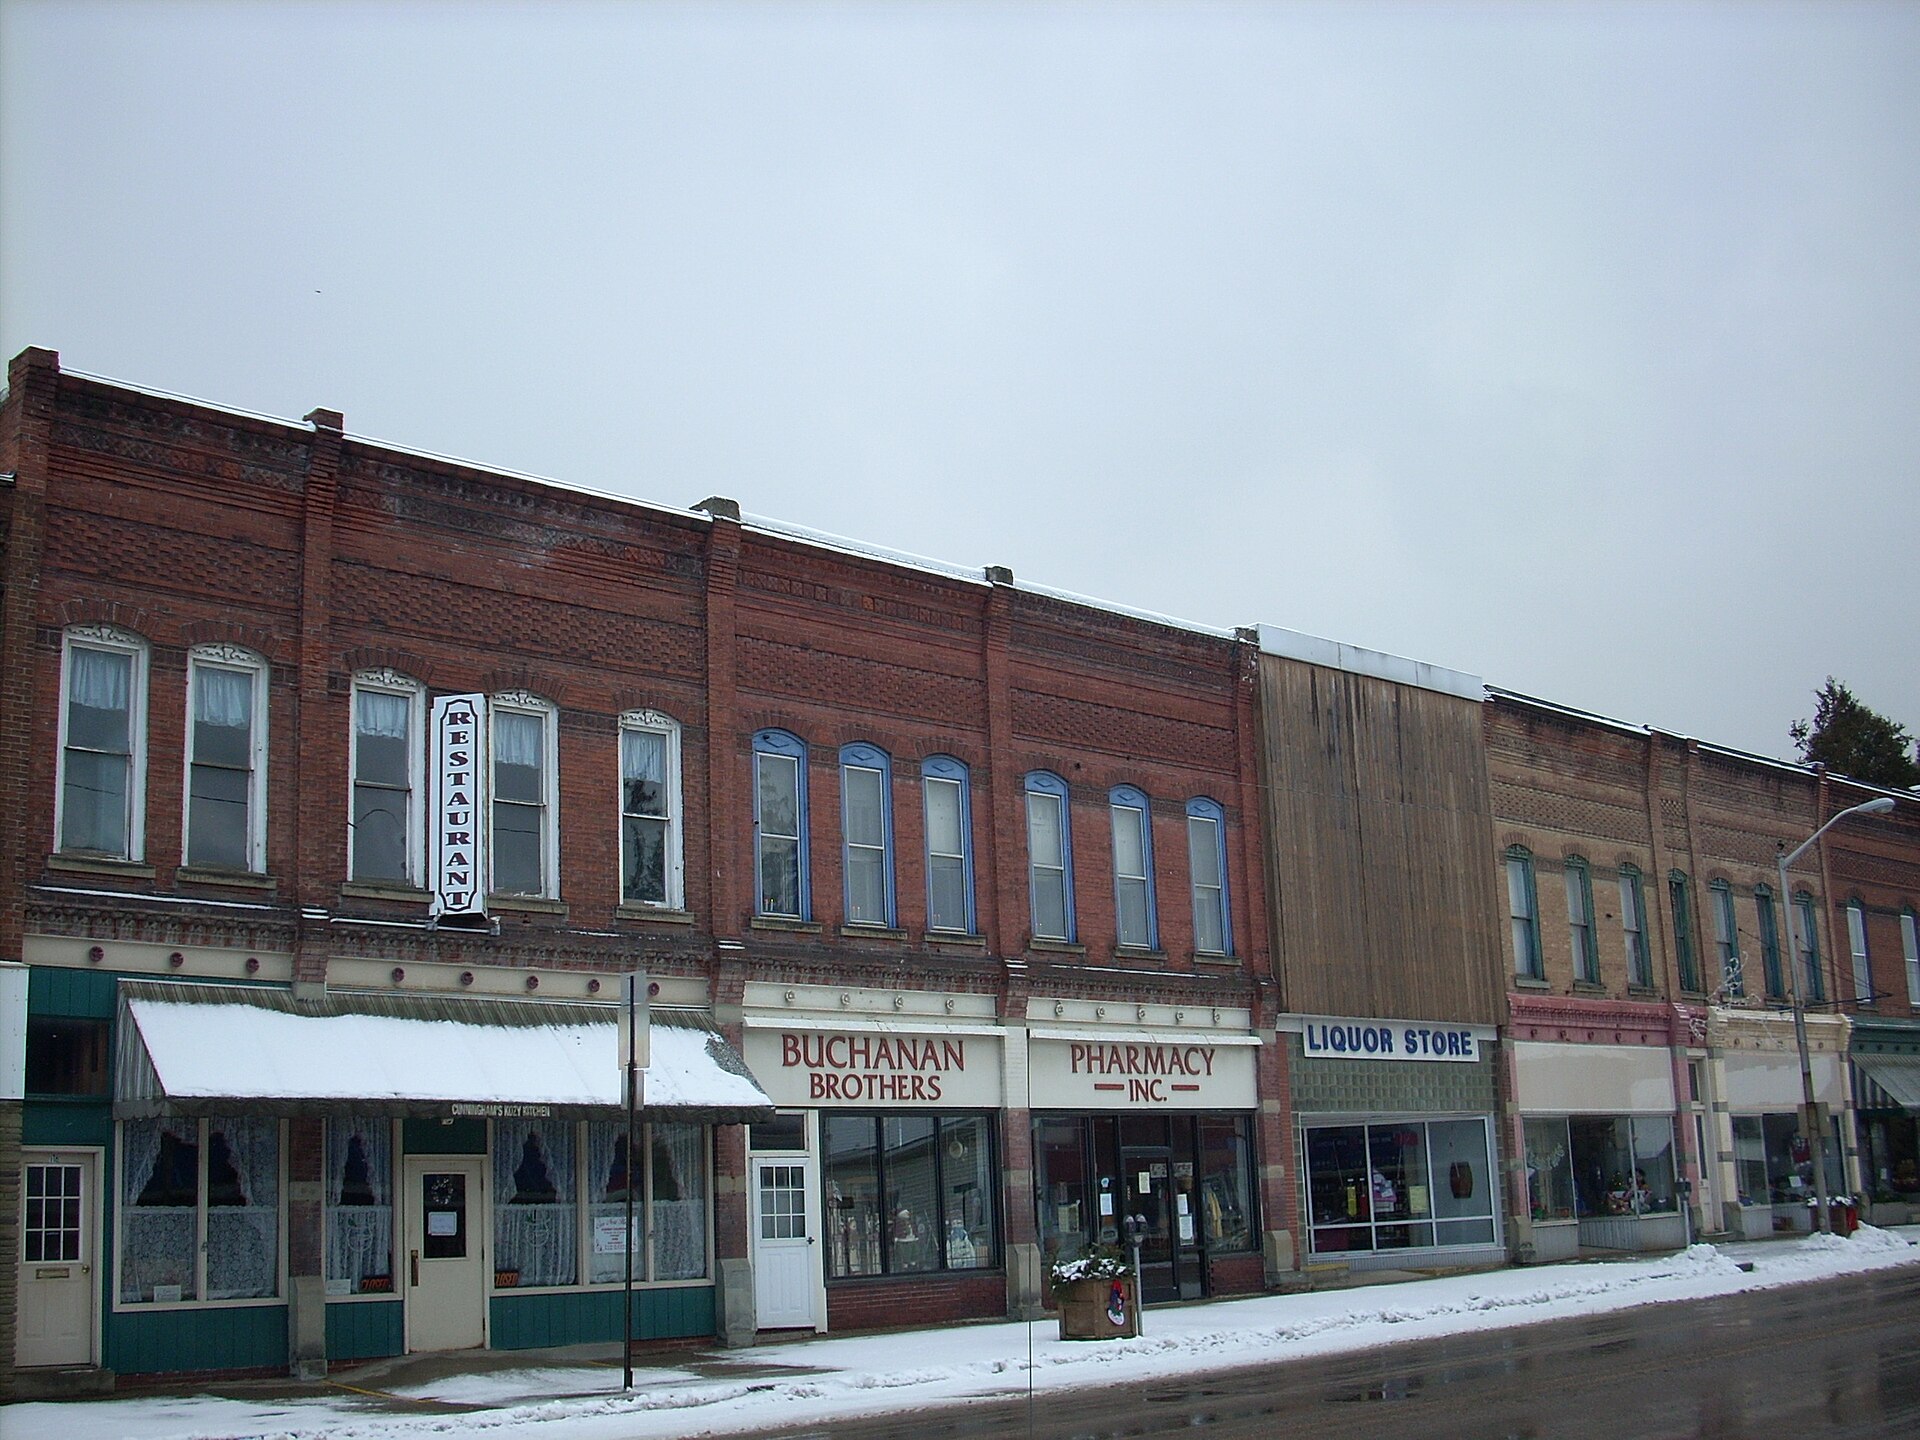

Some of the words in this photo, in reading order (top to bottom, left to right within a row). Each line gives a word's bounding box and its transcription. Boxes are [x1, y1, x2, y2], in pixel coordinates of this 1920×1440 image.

[445, 711, 472, 906] RESTAURANT
[782, 1034, 965, 1072] BUCHANAN
[1308, 1024, 1394, 1053] LIQUOR
[1404, 1029, 1473, 1056] STORE
[1070, 1043, 1216, 1076] PHARMACY
[809, 1072, 942, 1101] BROTHERS
[1128, 1078, 1168, 1102] INC.
[522, 1105, 551, 1118] KITCHEN
